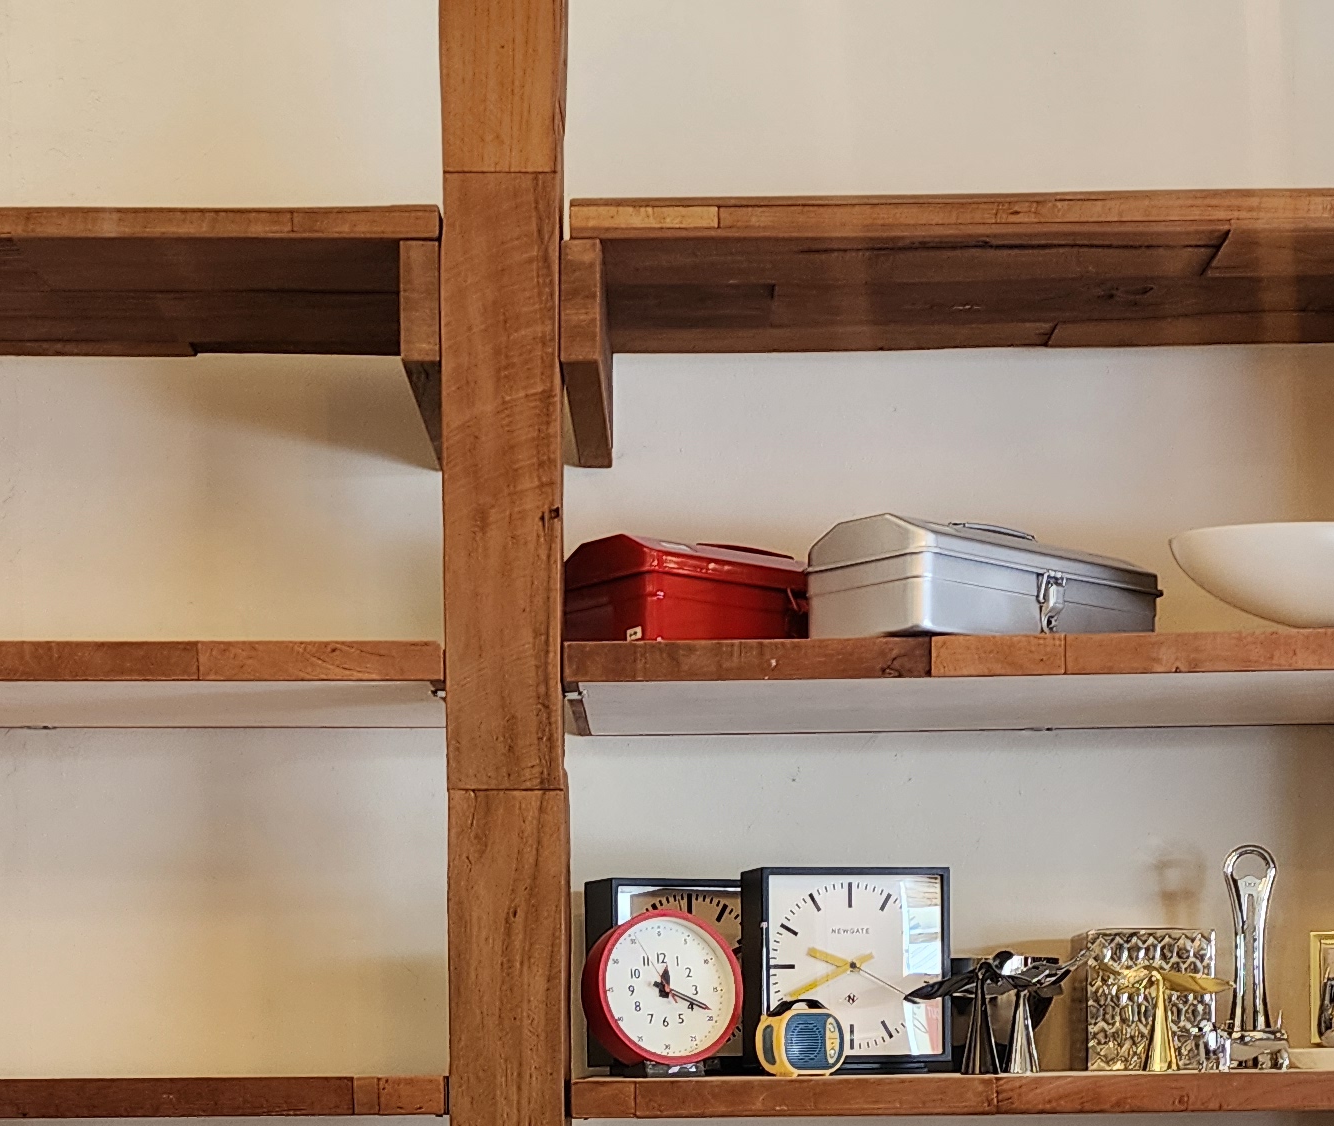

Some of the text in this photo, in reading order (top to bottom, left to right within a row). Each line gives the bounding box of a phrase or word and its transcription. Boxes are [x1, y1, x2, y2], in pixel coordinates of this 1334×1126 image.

[642, 956, 649, 966] 11
[656, 952, 667, 964] 12
[676, 956, 679, 966] 1
[630, 968, 641, 979] 10
[685, 967, 692, 978] 2
[628, 985, 635, 996] 9
[692, 984, 699, 996] 3
[635, 1001, 641, 1012] 8
[687, 1002, 694, 1012] 4
[647, 1014, 653, 1024] 7
[663, 1016, 669, 1028] 6
[678, 1014, 685, 1024] 5
